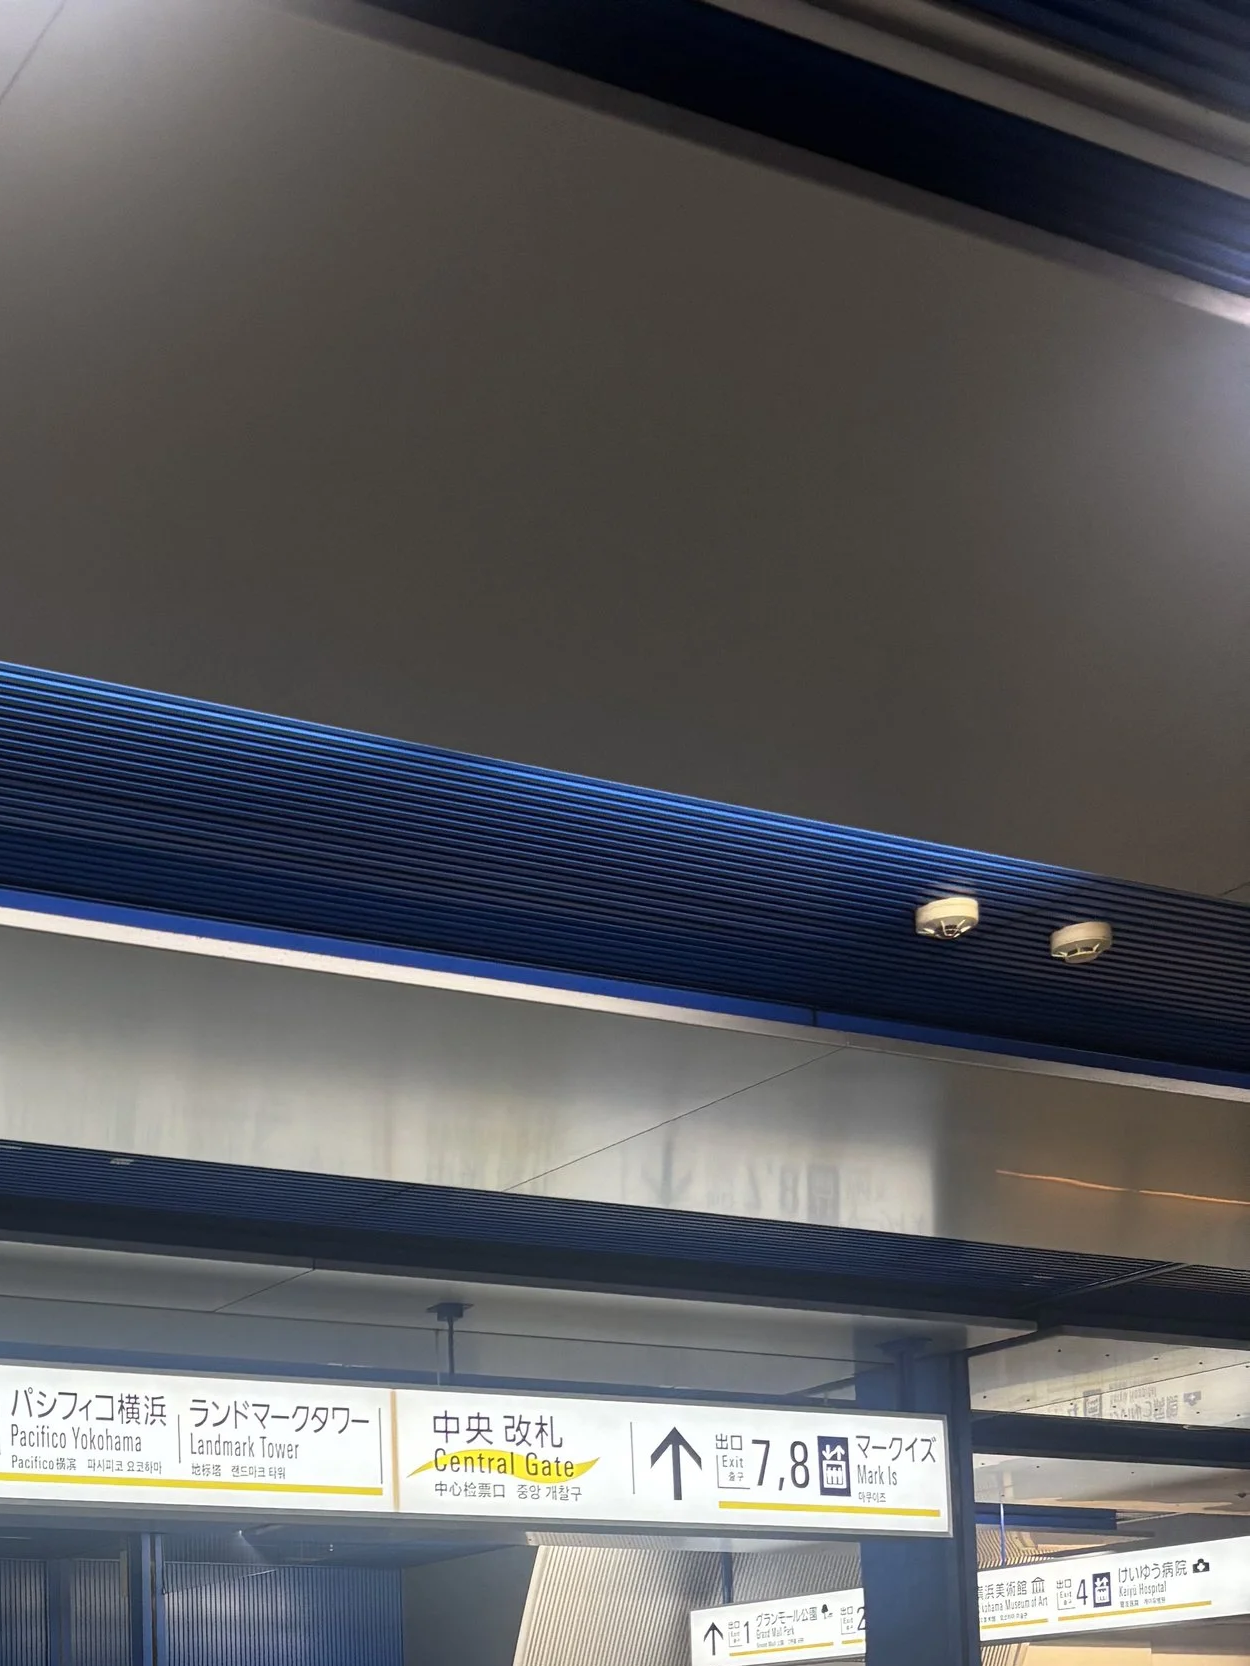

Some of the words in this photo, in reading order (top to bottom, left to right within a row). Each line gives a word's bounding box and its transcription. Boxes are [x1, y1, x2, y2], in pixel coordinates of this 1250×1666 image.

[11, 1386, 167, 1427] パシフィコ横浜
[190, 1399, 370, 1434] ランドマークタワー
[11, 1423, 67, 1449] Pacifico
[71, 1426, 142, 1452] Yokohama
[433, 1410, 494, 1445] 中央
[503, 1414, 563, 1448] 改札
[190, 1432, 255, 1458] Landmark
[259, 1436, 300, 1460] Tower
[715, 1433, 743, 1450] 出口
[855, 1435, 938, 1463] マークイズ
[434, 1447, 515, 1475] Central
[525, 1452, 575, 1478] Gate
[722, 1455, 744, 1468] Exit
[751, 1439, 810, 1491] 7,8
[857, 1464, 885, 1486] Mark
[887, 1465, 898, 1486] Is
[434, 1480, 506, 1498] 中心检票口
[517, 1484, 541, 1500] 중앙
[1118, 1559, 1188, 1583] けいゆう病院
[1056, 1579, 1072, 1589] 出口
[1076, 1579, 1088, 1605] 4
[1138, 1581, 1167, 1596] Hospital
[1005, 1598, 1030, 1610] Museum
[755, 1606, 818, 1628] グランモール公園
[856, 1606, 866, 1631] 2
[743, 1620, 750, 1644] 1
